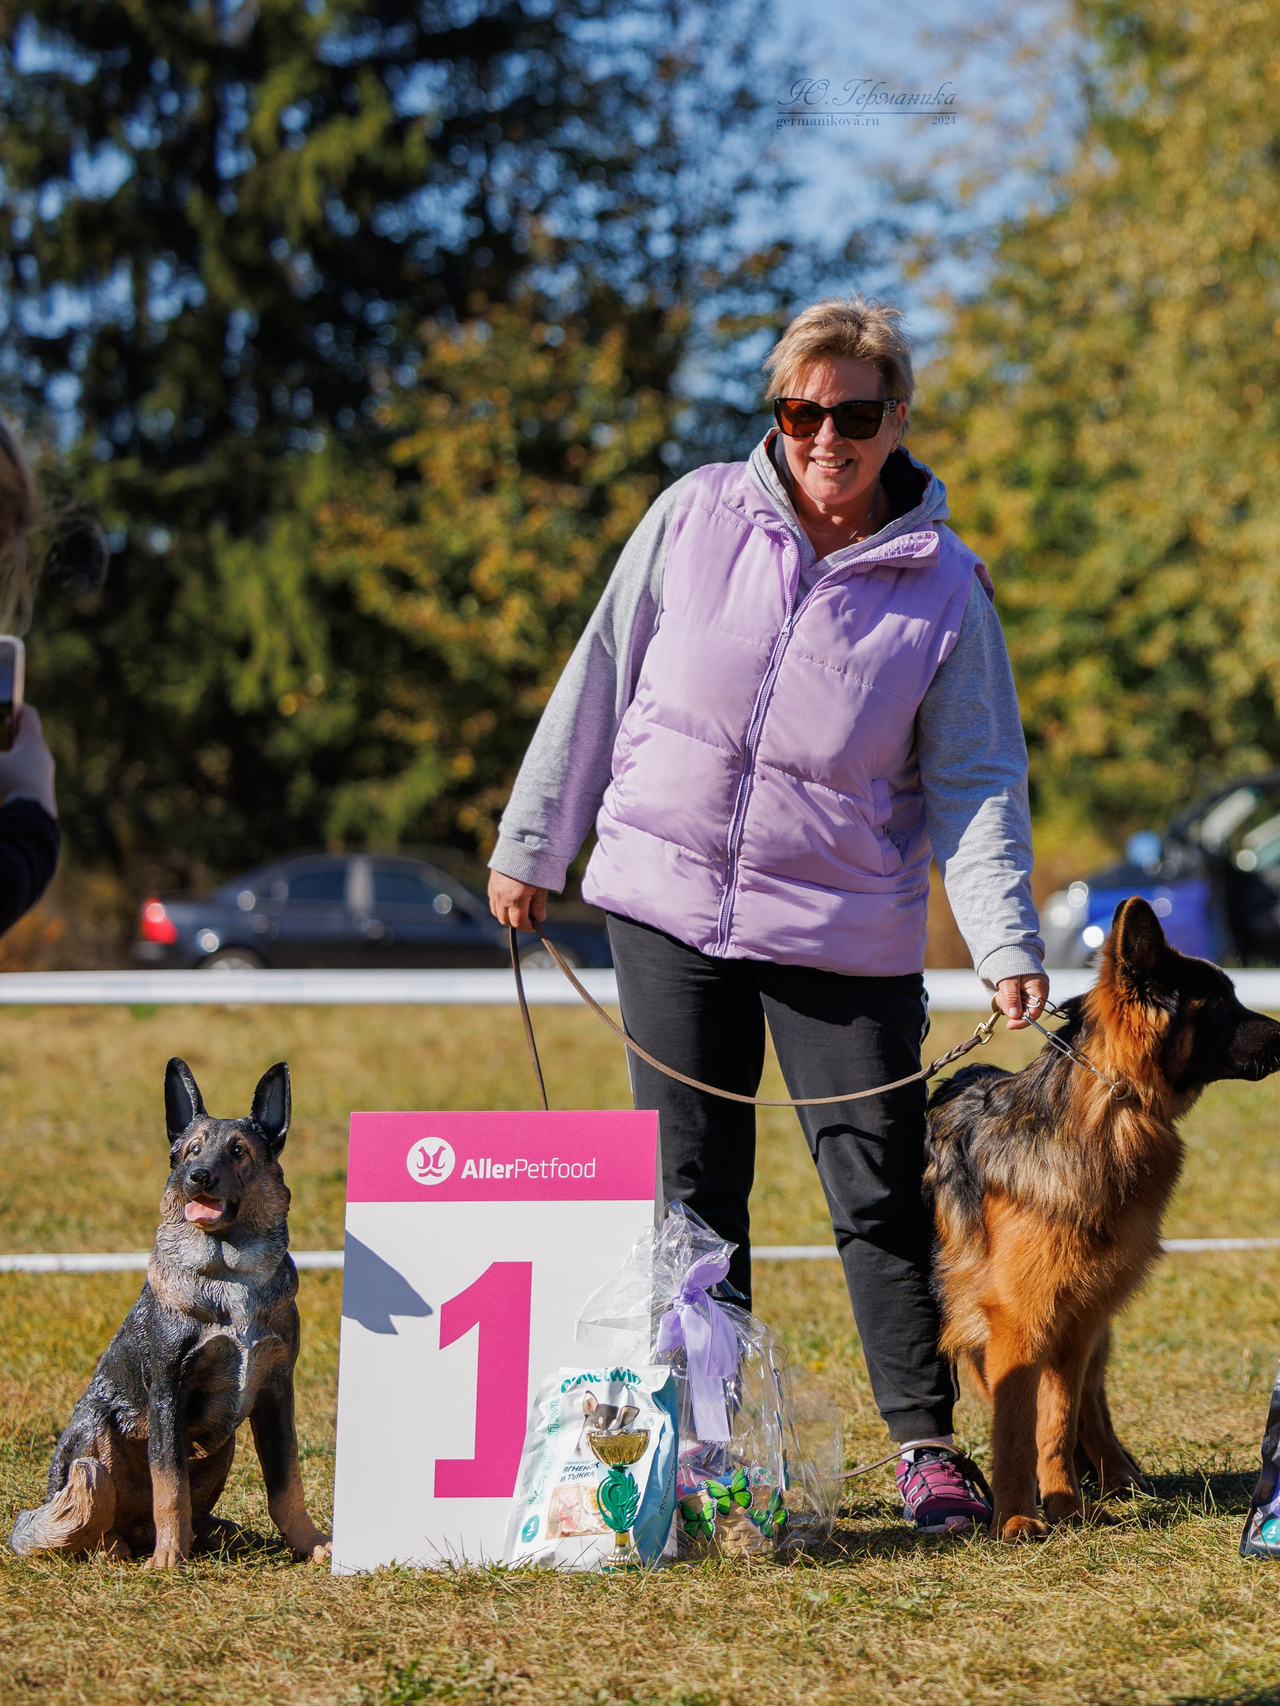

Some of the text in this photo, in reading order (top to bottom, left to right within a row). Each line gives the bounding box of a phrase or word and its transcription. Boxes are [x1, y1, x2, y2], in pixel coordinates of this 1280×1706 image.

[461, 1157, 596, 1179] AllerPetfood
[434, 1261, 533, 1498] 1
[1269, 1525, 1277, 1535] 1
